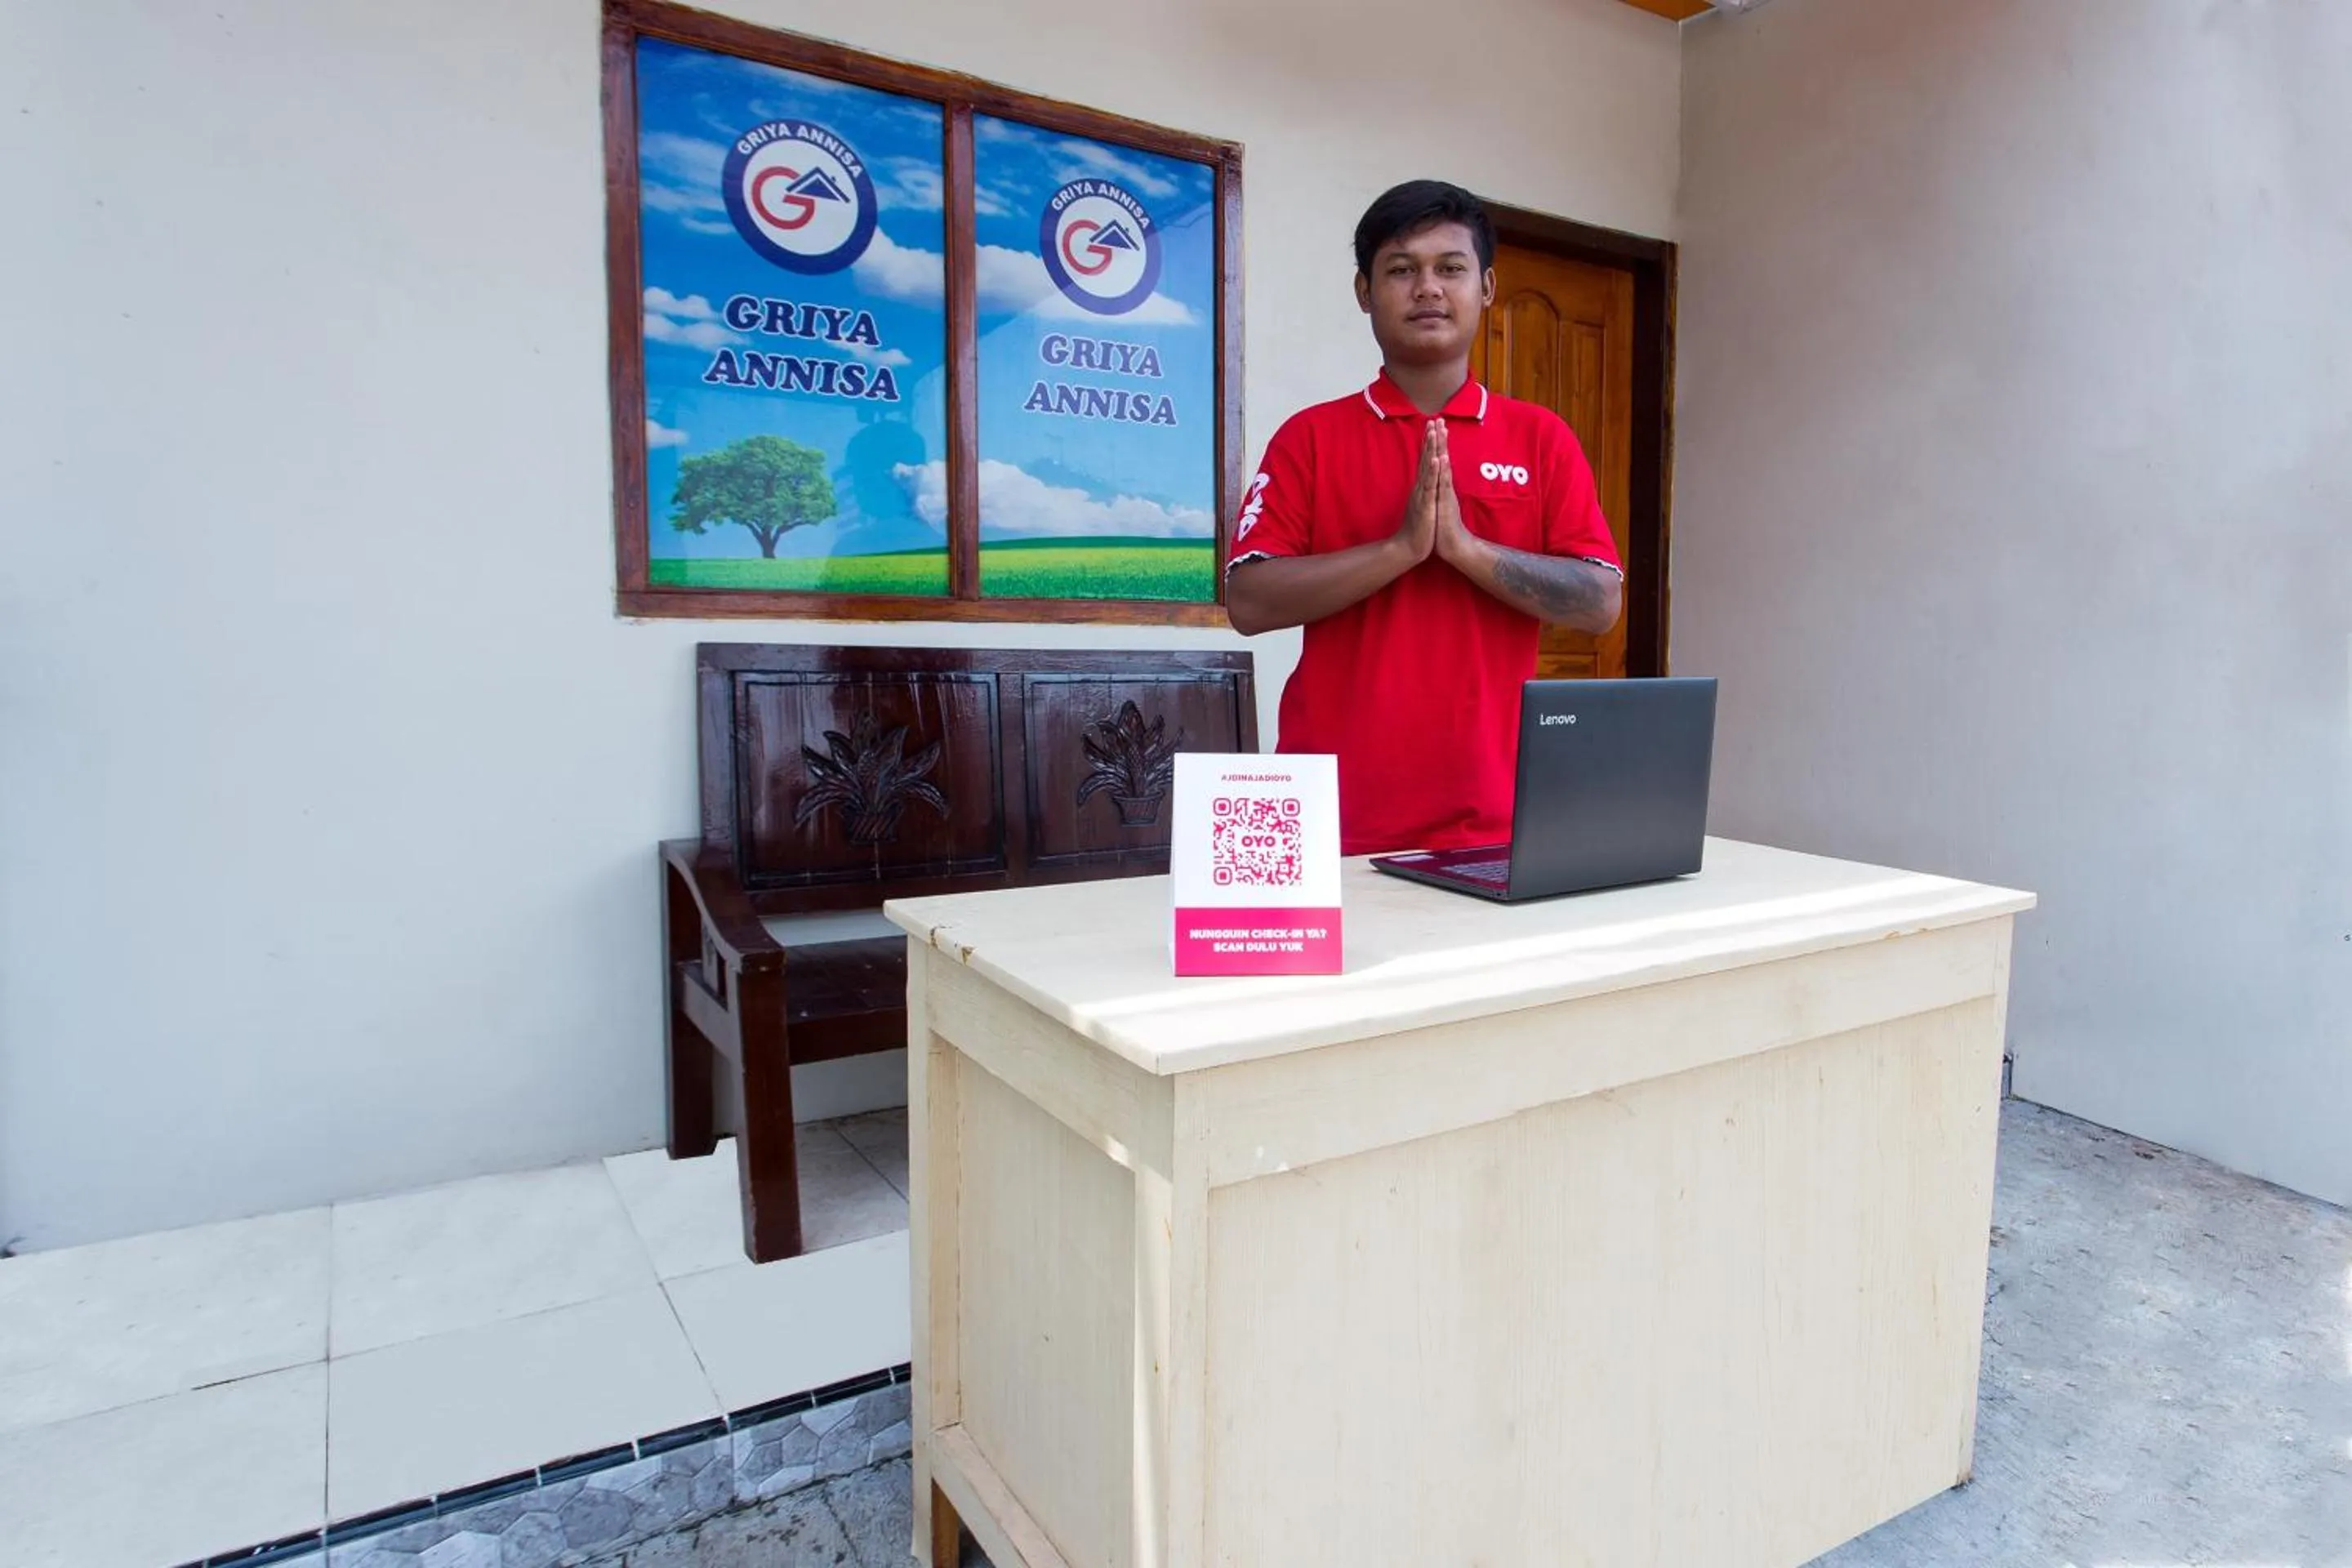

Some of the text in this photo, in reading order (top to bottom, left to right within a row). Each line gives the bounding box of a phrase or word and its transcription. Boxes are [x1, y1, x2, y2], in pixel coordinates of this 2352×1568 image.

[737, 122, 863, 179] GRIYA ANNISA
[1051, 182, 1150, 229] GRIYA ANNISA
[724, 294, 881, 347] GRIYA
[702, 347, 901, 402] ANNISA
[1040, 332, 1163, 378] GRIYA
[1022, 381, 1178, 427] ANNISA
[1480, 461, 1530, 485] OYO
[1539, 714, 1577, 726] Lenovo
[1241, 835, 1276, 848] OYO
[1213, 942, 1303, 952] SCAN DULU YUK
[1251, 929, 1303, 939] CHECK-IN
[1306, 929, 1327, 939] YA?
